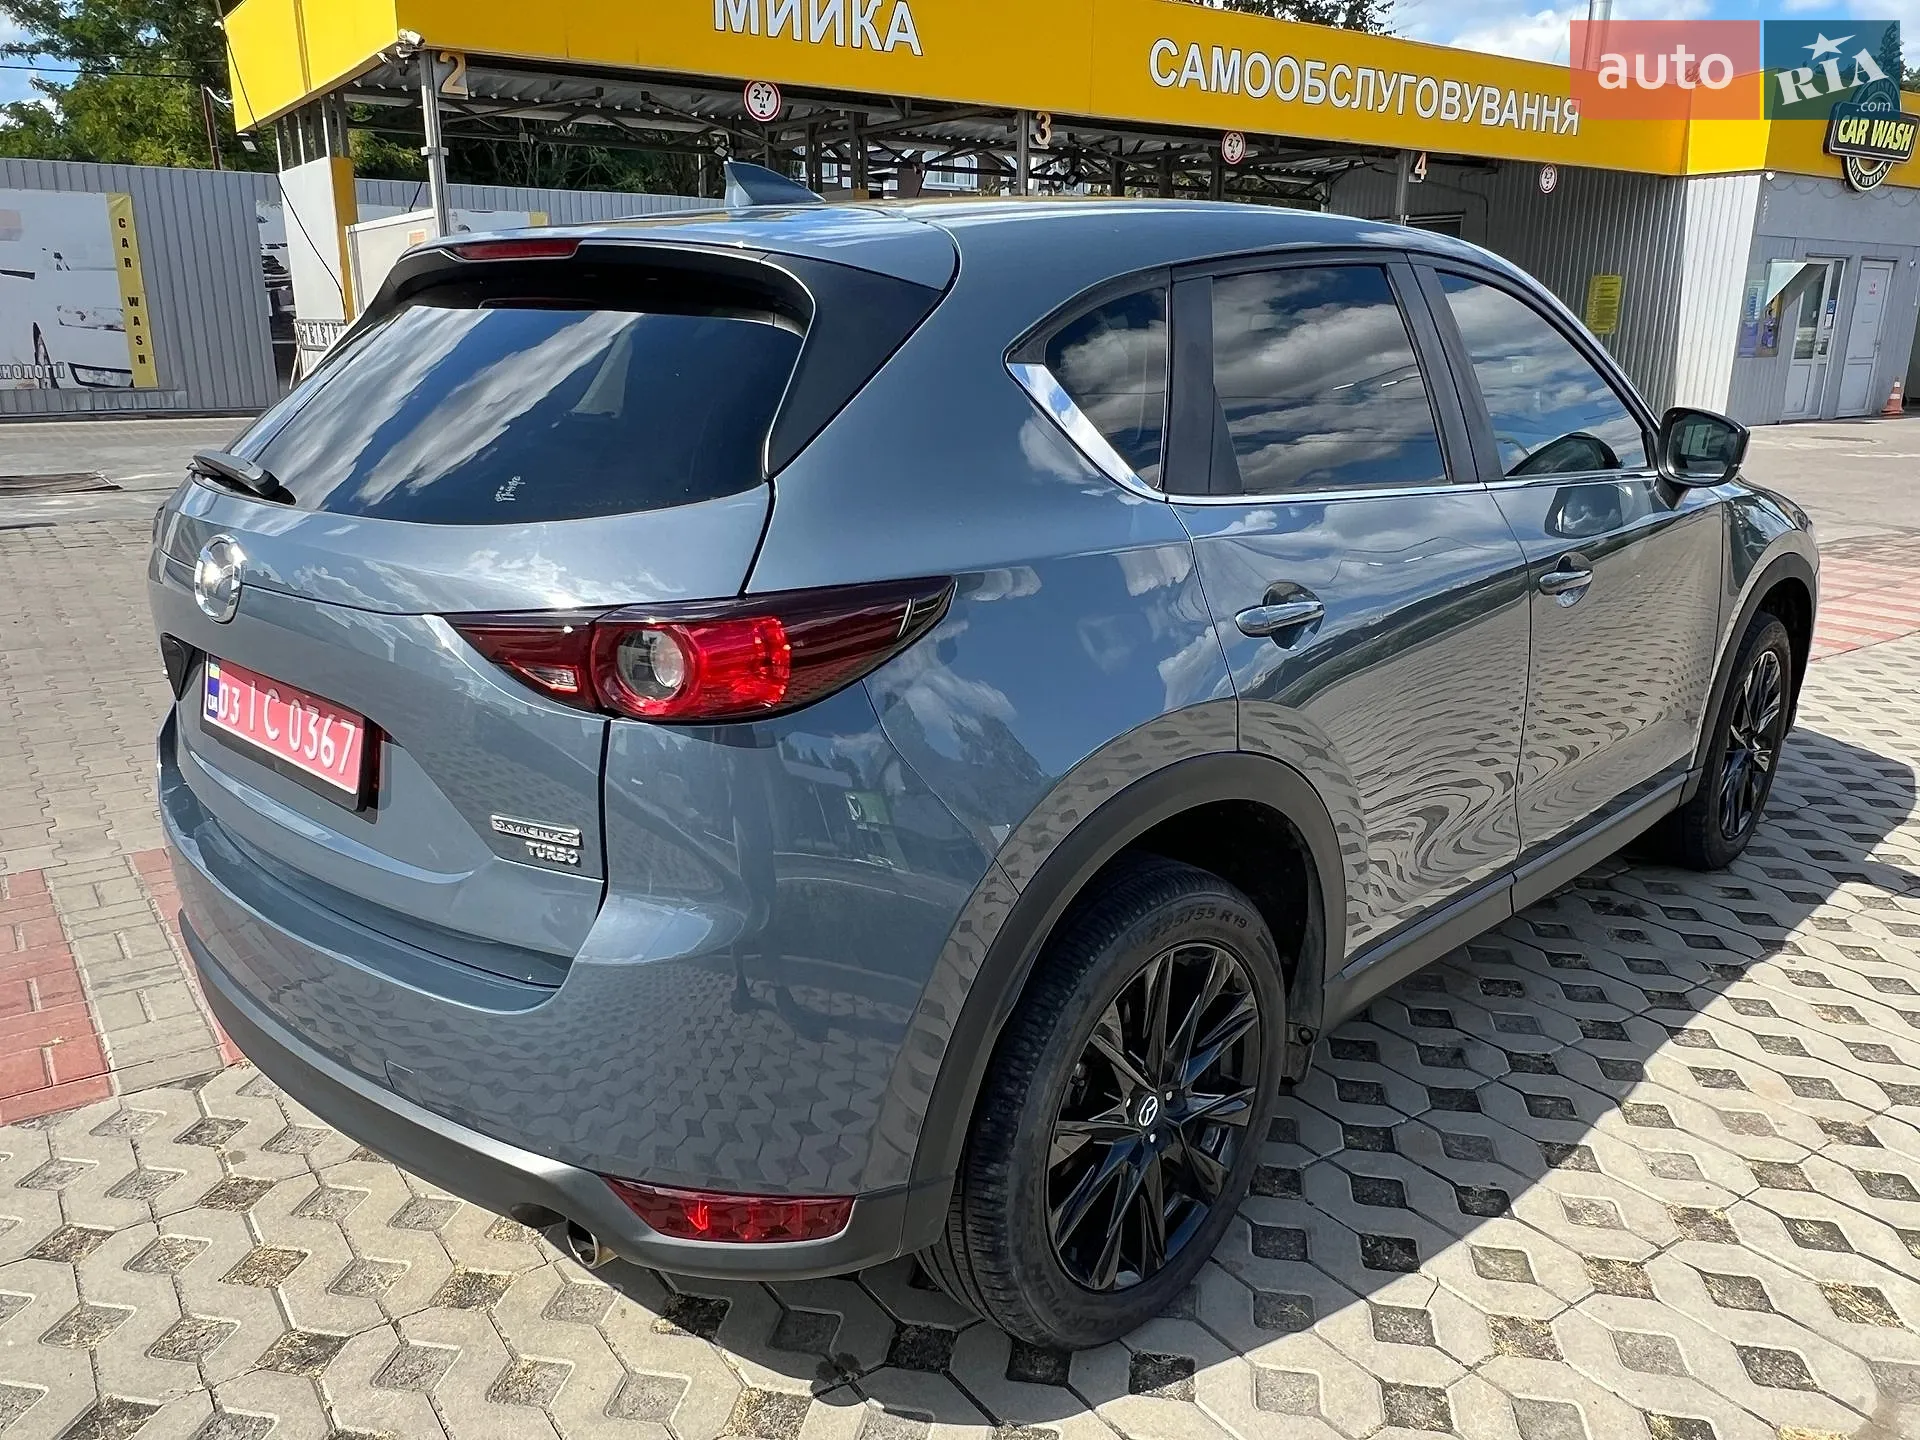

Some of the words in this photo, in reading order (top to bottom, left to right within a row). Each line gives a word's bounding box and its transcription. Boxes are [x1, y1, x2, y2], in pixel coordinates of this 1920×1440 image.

[439, 51, 469, 96] 2
[1149, 38, 1582, 137] САМООБСЛУГОВУВАННЯ
[753, 88, 772, 102] 2,7
[1035, 111, 1052, 146] 3
[1838, 115, 1869, 146] CAR
[1870, 119, 1915, 152] WASH
[1414, 151, 1427, 180] 4
[118, 217, 132, 268] CAR
[127, 296, 146, 365] WASH
[0, 361, 66, 380] нології
[206, 693, 218, 712] UA
[288, 698, 356, 776] 0367
[525, 840, 579, 864] TURBO
[1219, 908, 1248, 929] R19
